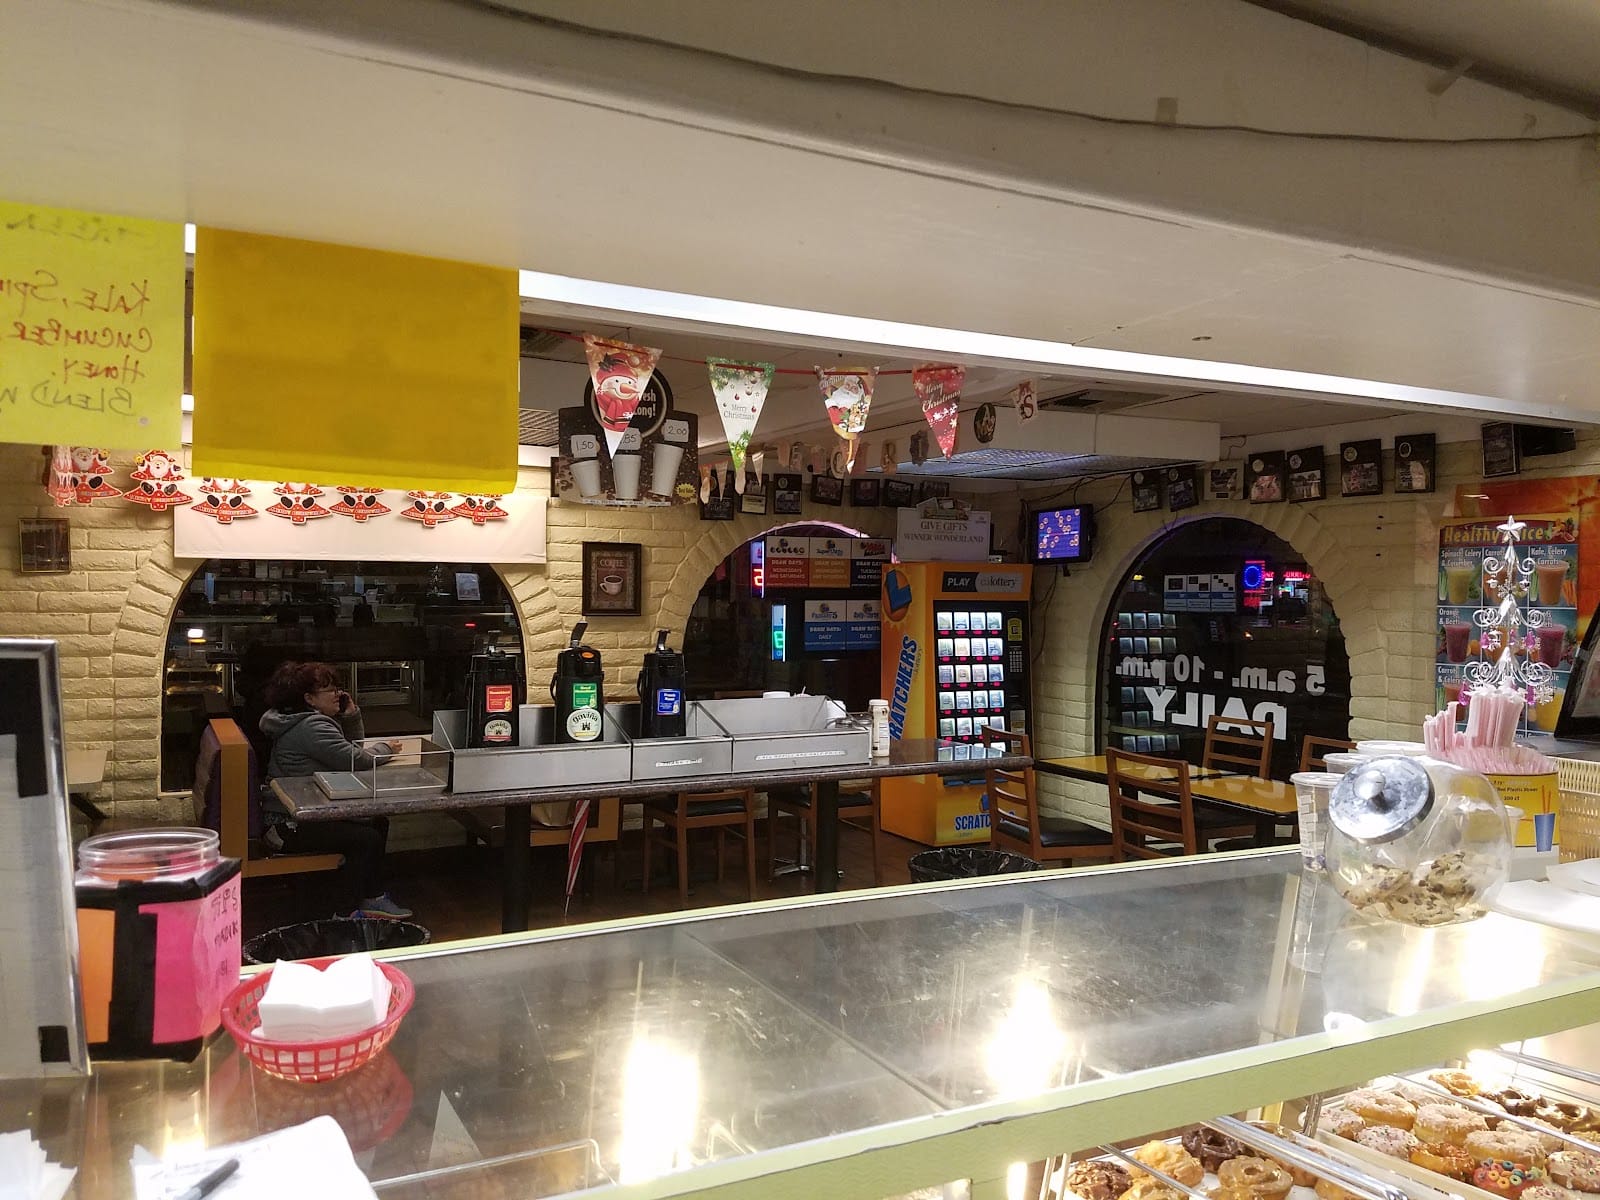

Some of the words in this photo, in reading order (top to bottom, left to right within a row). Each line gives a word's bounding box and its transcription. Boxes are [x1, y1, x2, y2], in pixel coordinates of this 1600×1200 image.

[723, 410, 755, 421] Christmas
[921, 520, 941, 531] GIVE
[943, 521, 968, 532] GIFTS
[934, 534, 984, 543] WONDERLAND
[1444, 526, 1499, 544] Healthy
[947, 577, 971, 587] PLAY
